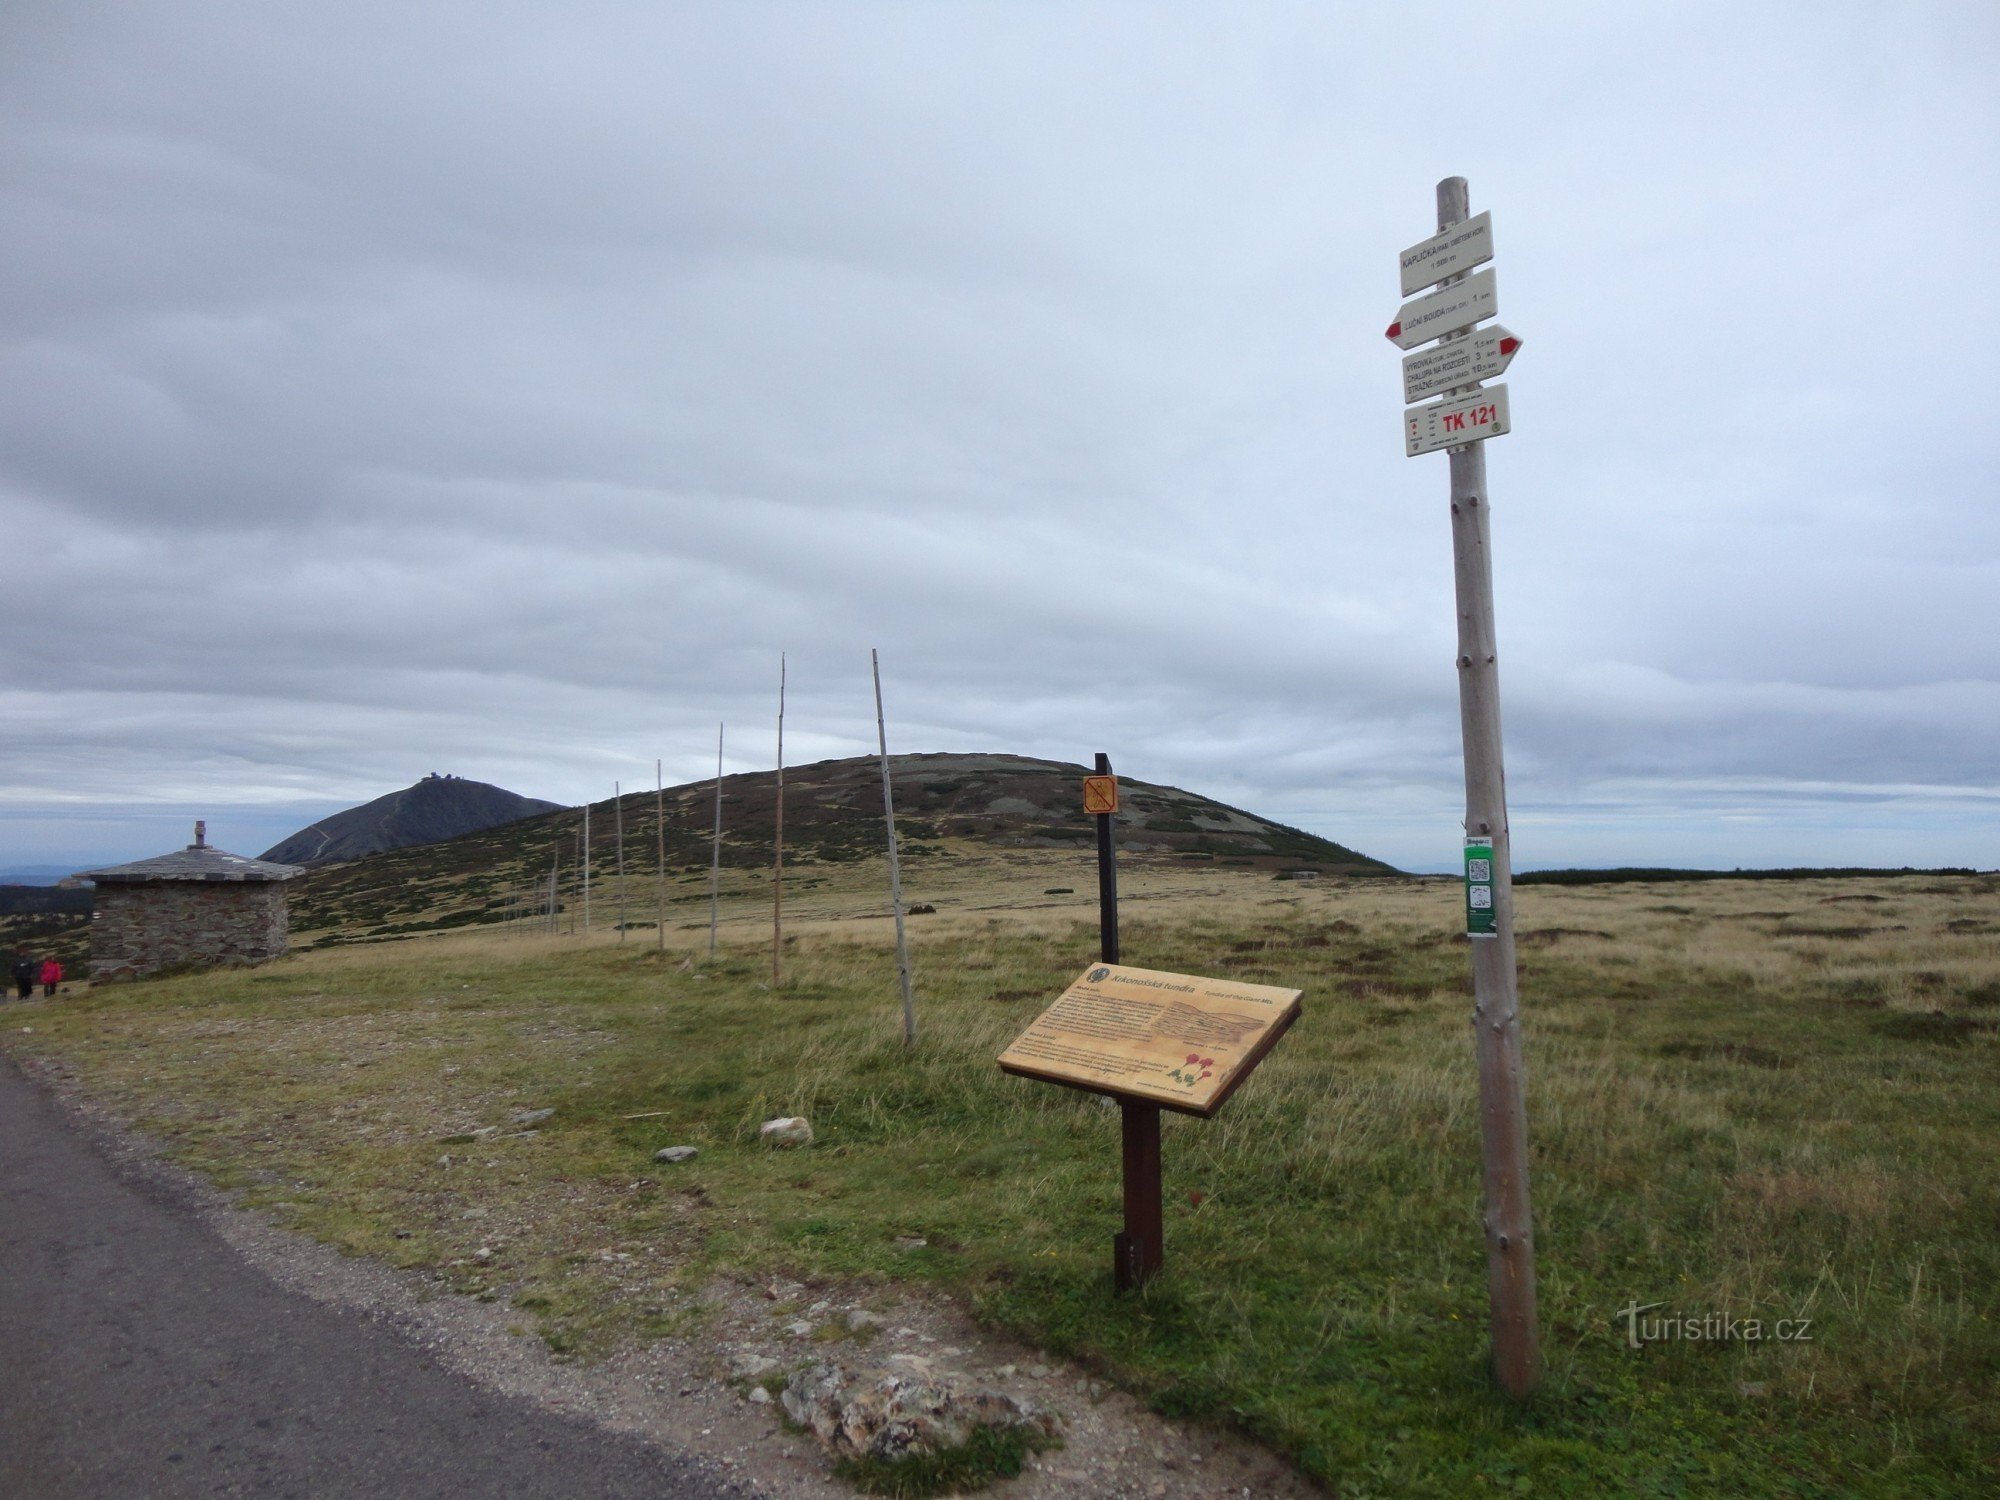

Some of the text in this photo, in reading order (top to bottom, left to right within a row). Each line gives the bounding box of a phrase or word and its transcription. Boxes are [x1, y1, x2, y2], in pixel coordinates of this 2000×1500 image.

[1403, 246, 1436, 268] KAPLIČKA
[1423, 308, 1446, 323] BOUDA
[1407, 368, 1432, 383] CHALUPA
[1433, 365, 1441, 374] NA
[1475, 352, 1482, 361] 3
[1487, 361, 1498, 369] km
[1443, 404, 1497, 433] TK 121
[1112, 974, 1163, 989] Krkonošská
[1164, 981, 1196, 994] tundra
[1205, 990, 1225, 998] Tundra
